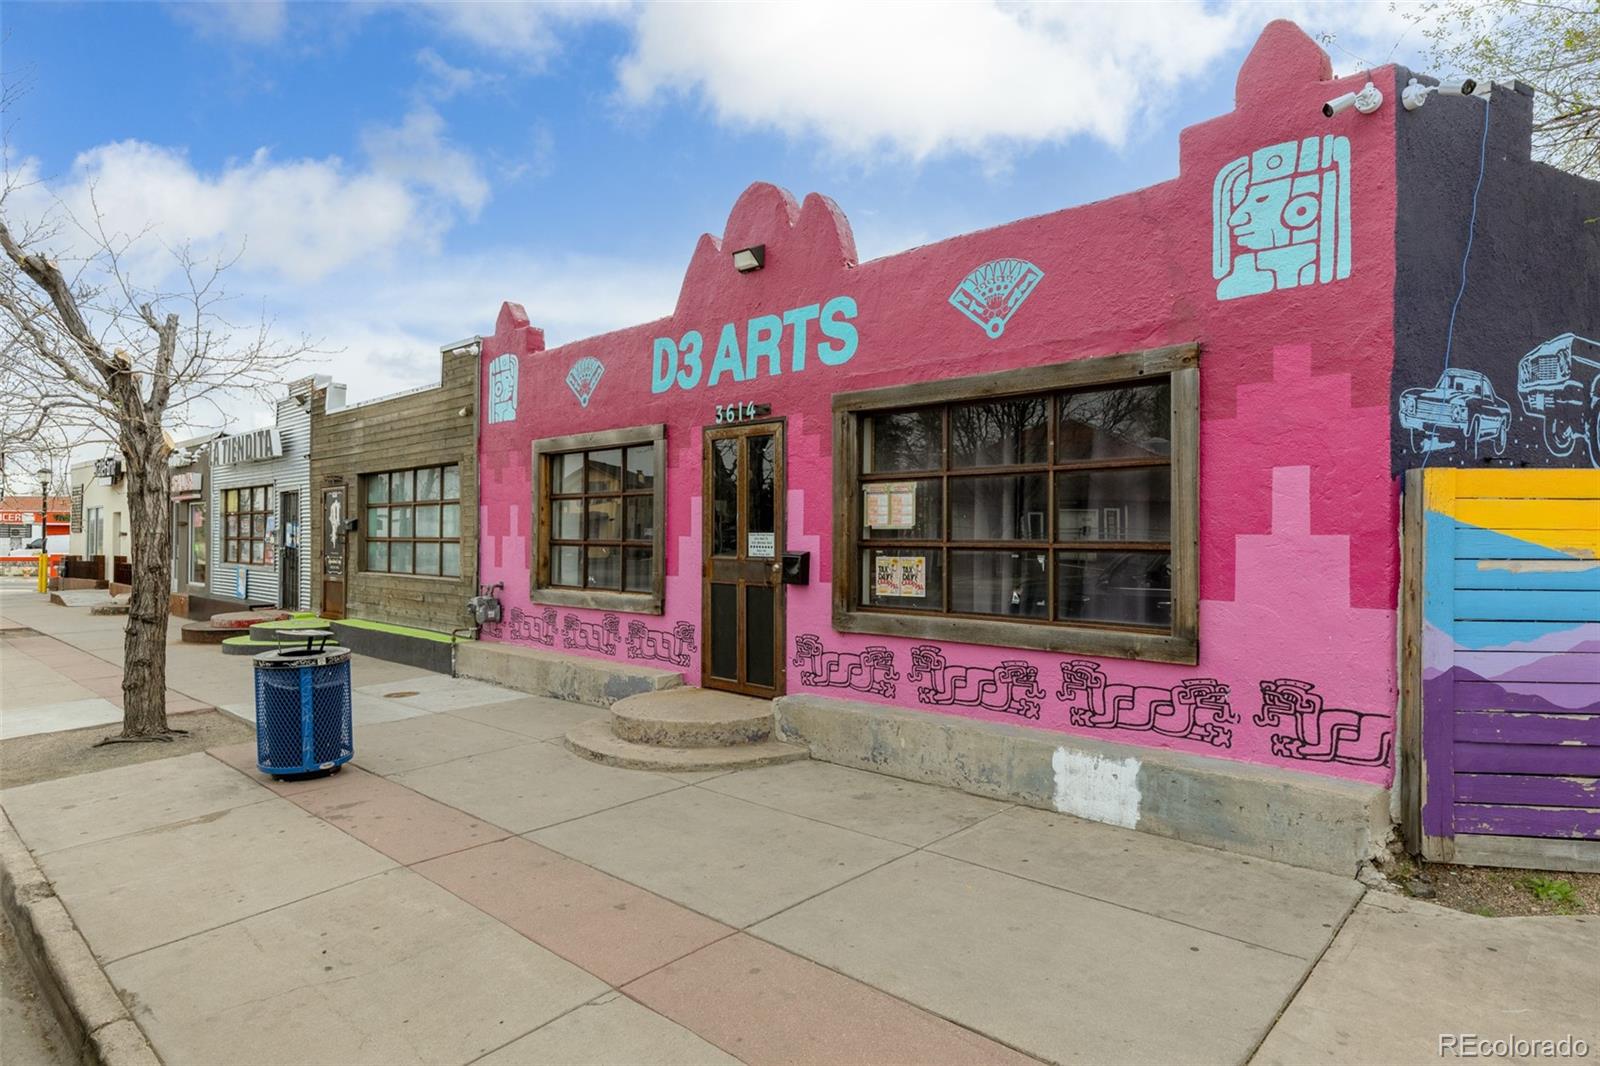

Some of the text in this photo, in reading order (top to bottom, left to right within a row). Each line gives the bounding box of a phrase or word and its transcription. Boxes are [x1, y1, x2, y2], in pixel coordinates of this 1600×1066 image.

[651, 296, 859, 394] D3 ARTS
[715, 401, 756, 424] 3614
[222, 429, 273, 464] TIENDITA
[0, 512, 22, 522] CER
